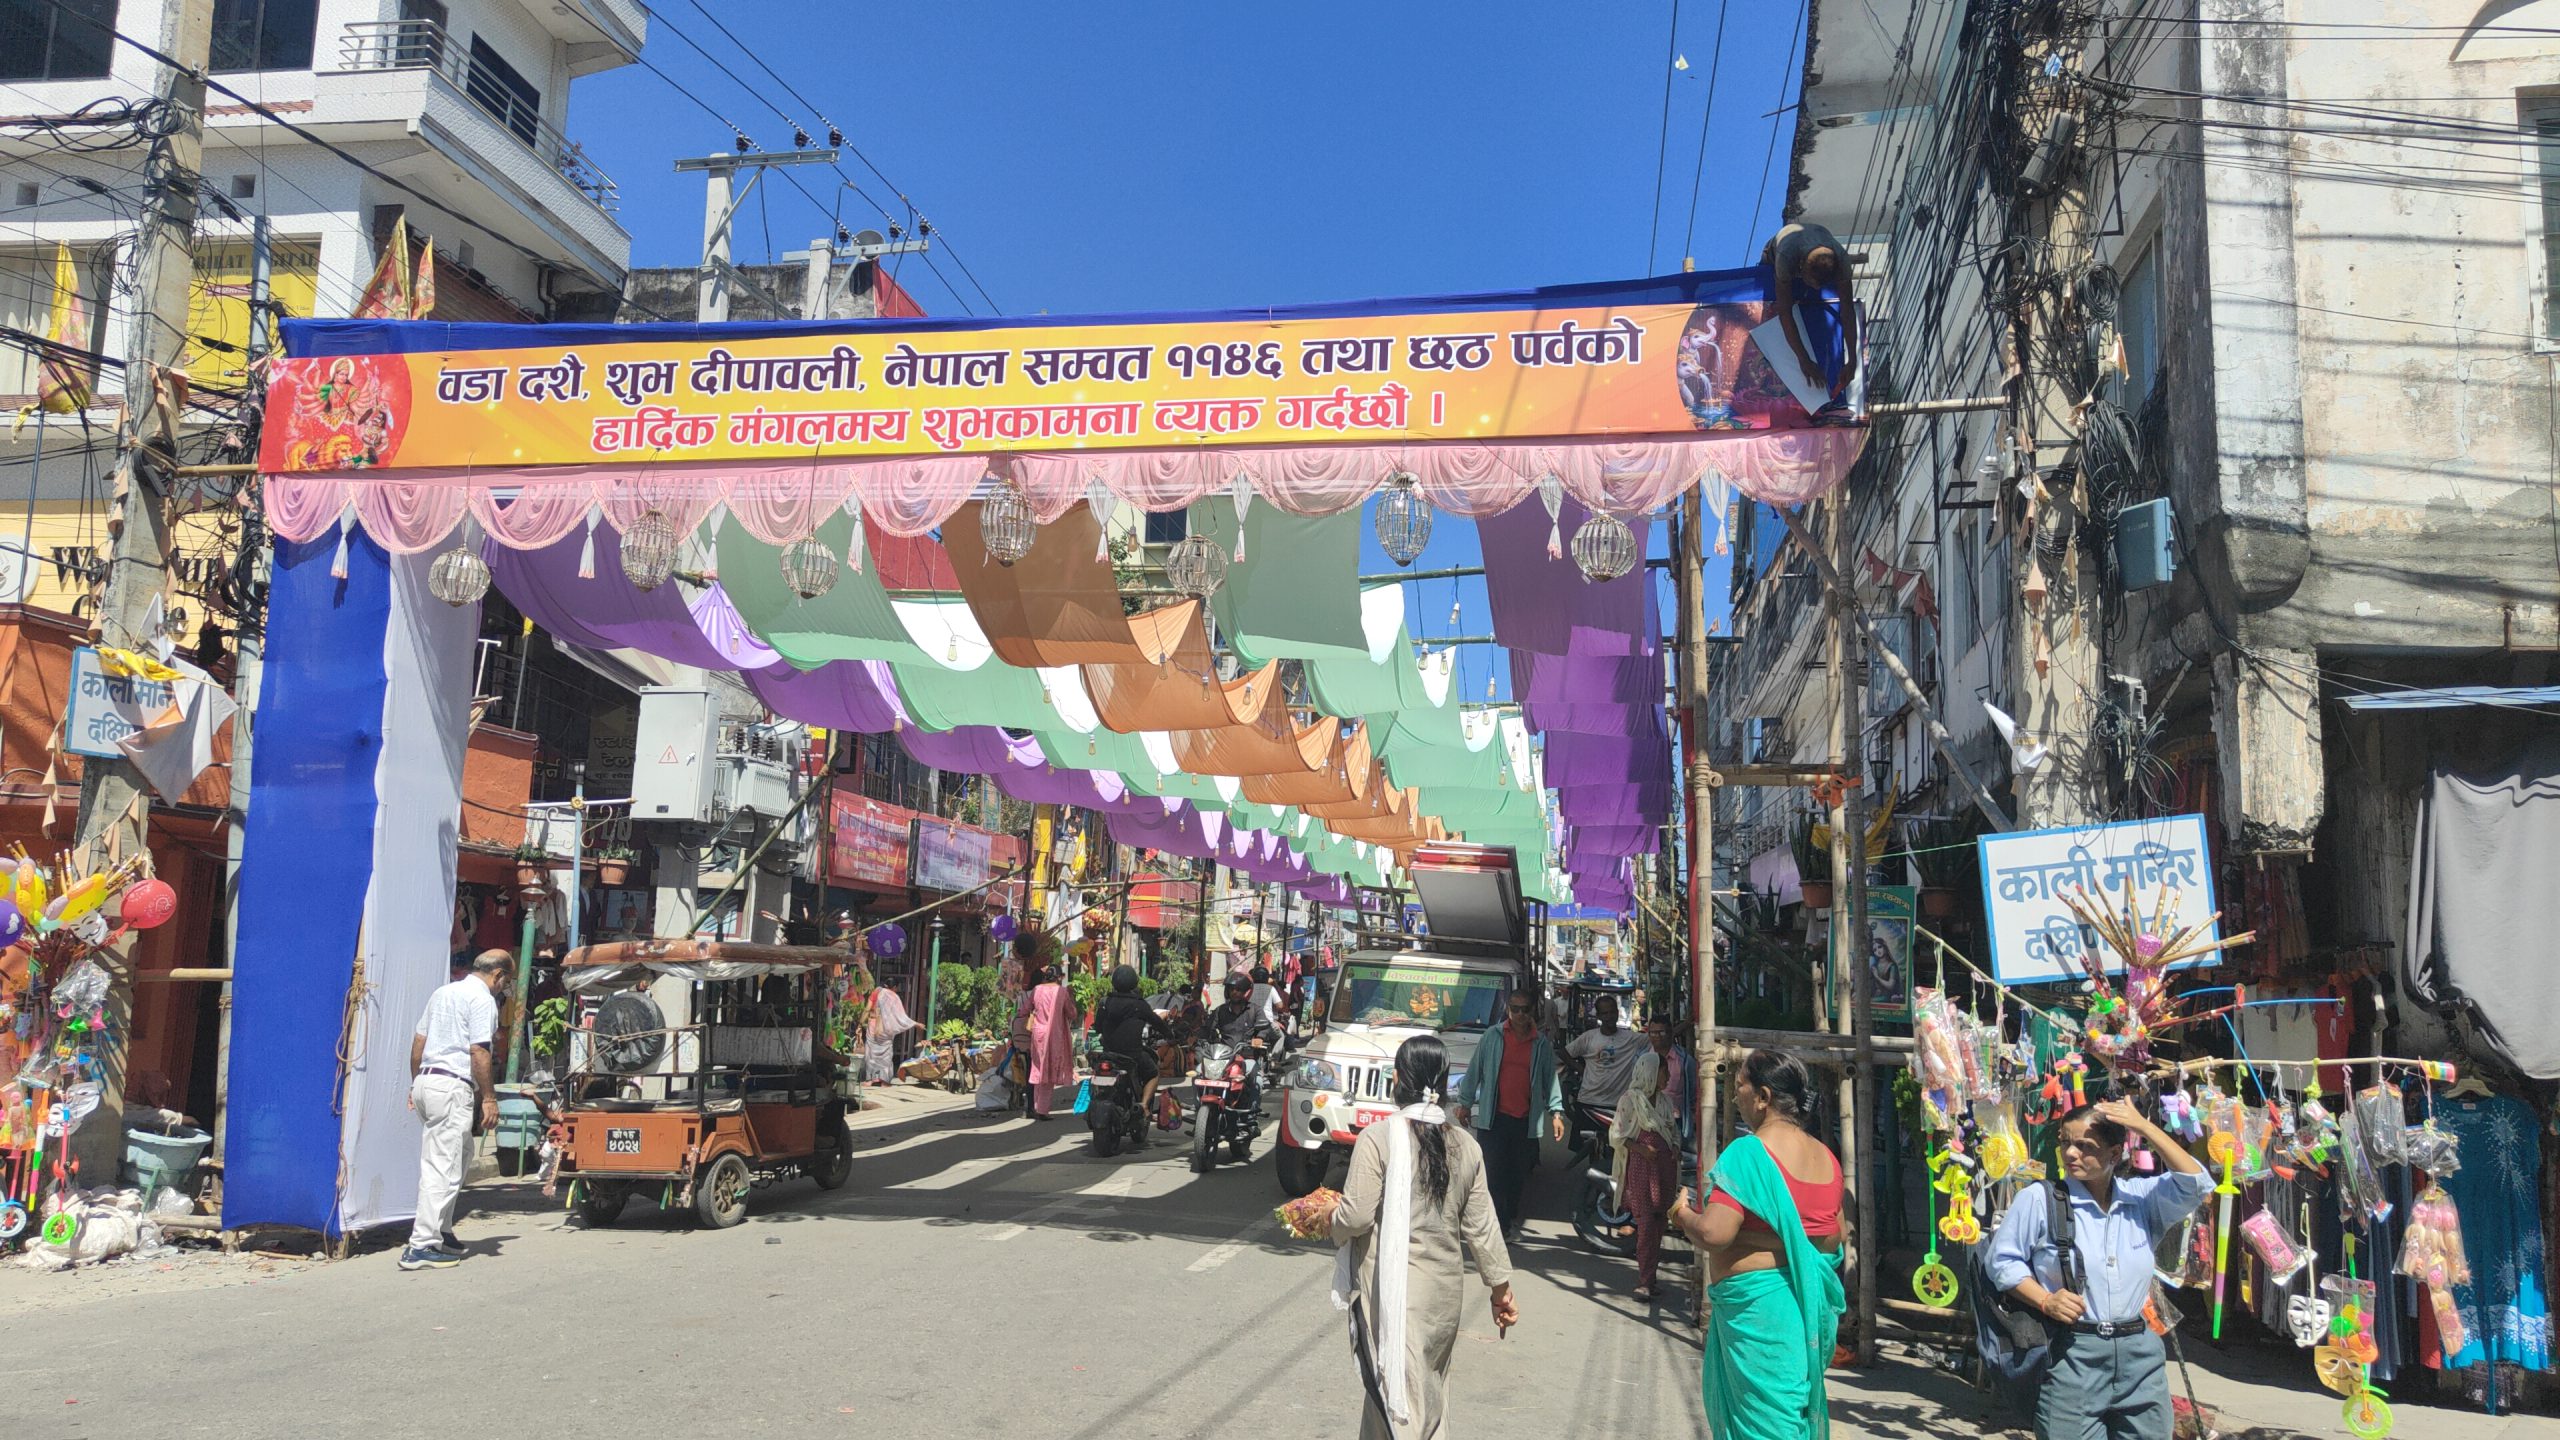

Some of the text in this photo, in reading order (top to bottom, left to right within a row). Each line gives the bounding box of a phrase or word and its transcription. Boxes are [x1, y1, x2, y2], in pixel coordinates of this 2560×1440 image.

[438, 317, 1645, 405] वडा दशै, शुभ दीपावली, नेपाल सम्वत ११४६ तथा छठ पर्वको
[591, 406, 719, 452] हार्दिक
[729, 407, 911, 446] मंगलमय
[922, 402, 1143, 449] शुभकामना
[1154, 398, 1265, 433] व्यक्त
[1277, 382, 1412, 431] गर्दछौं
[1997, 841, 2199, 902] काली मन्दिर
[2024, 914, 2110, 963] दक्षिण
